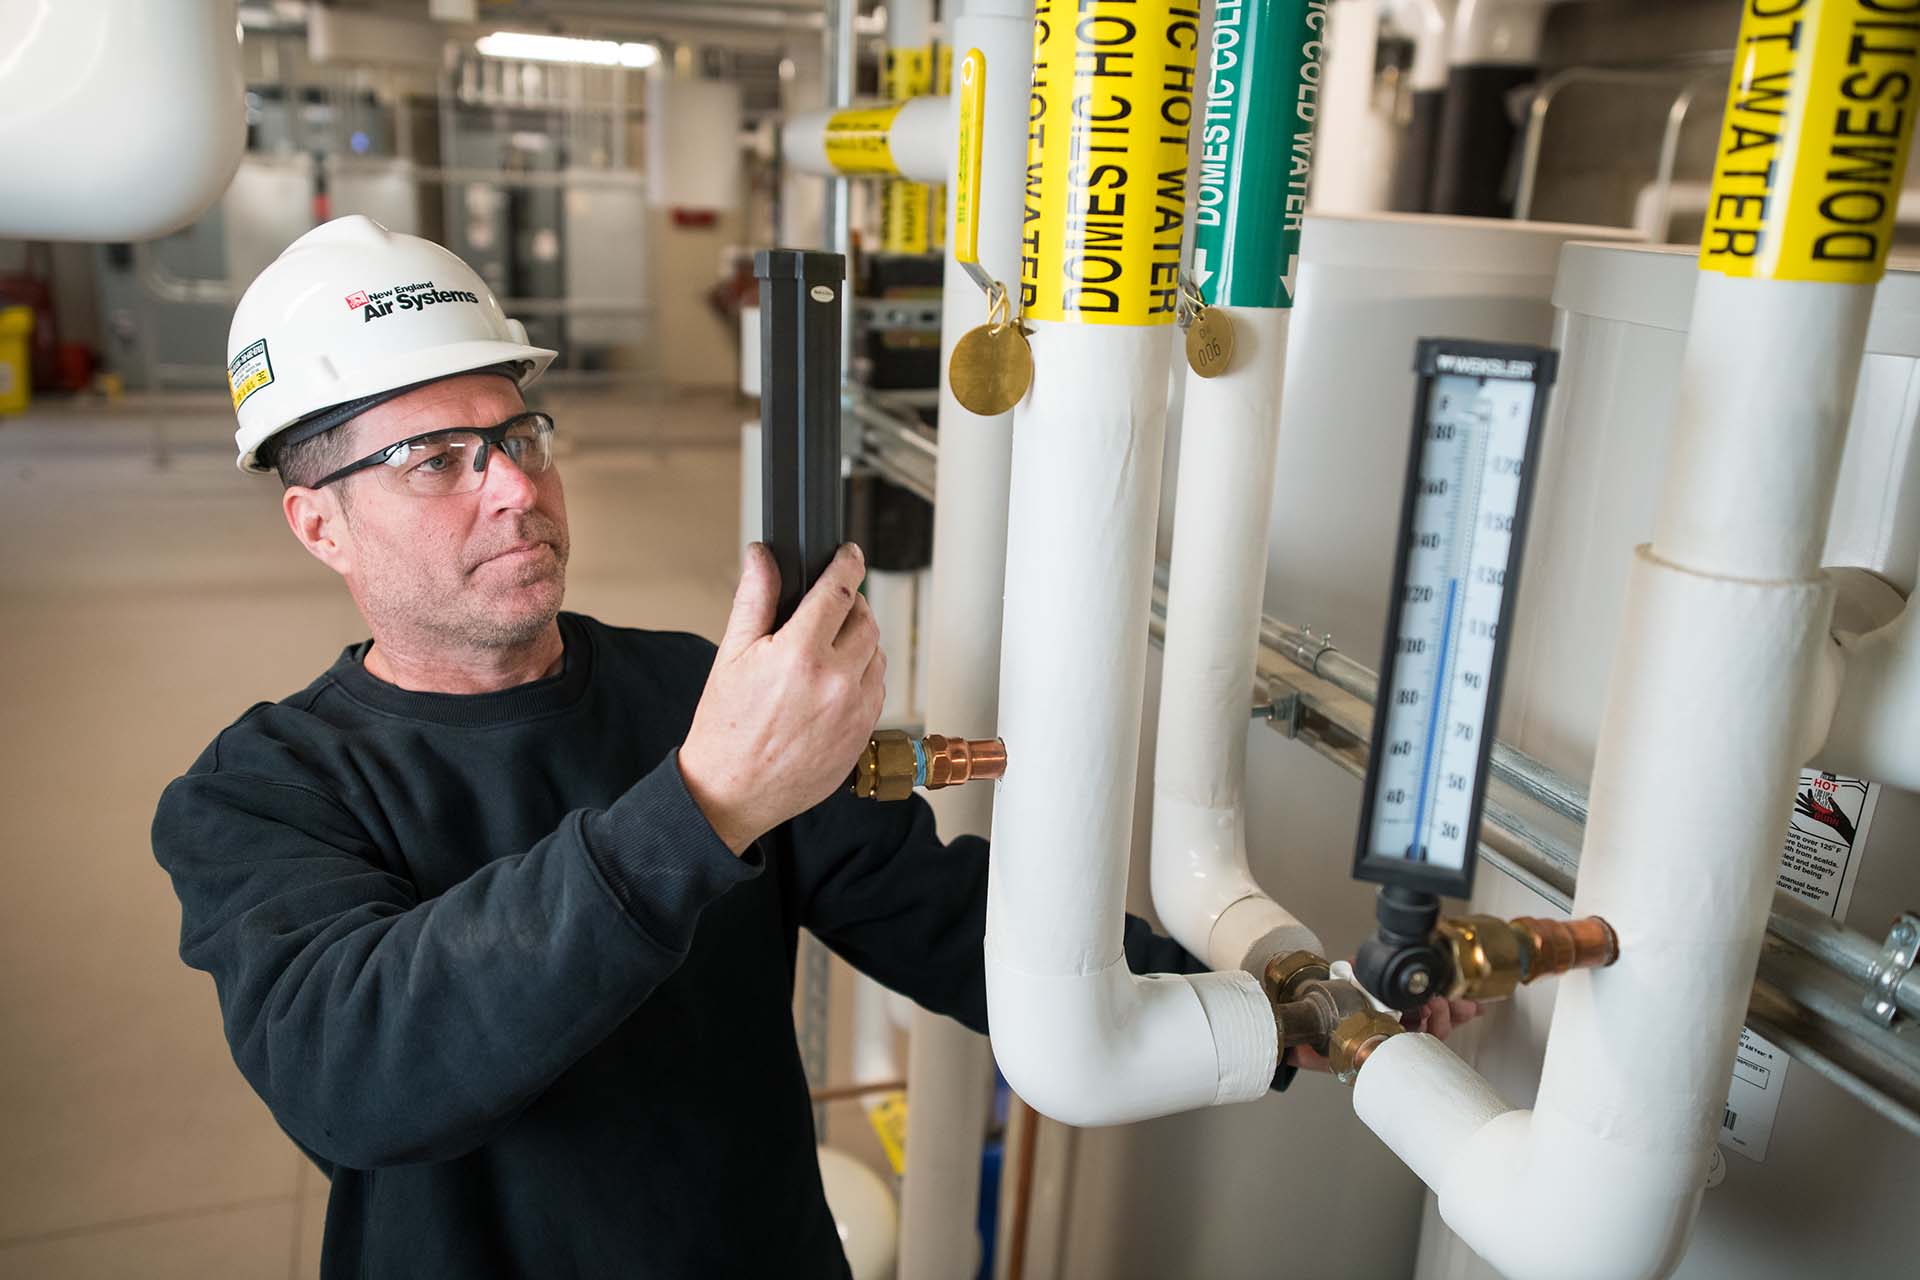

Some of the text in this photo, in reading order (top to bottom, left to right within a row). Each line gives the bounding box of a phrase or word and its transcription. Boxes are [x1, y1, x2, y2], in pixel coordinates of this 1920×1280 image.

[1160, 64, 1197, 154] HOT
[1296, 41, 1322, 122] COLD
[1195, 79, 1235, 226] DOMESTIC
[1283, 130, 1313, 231] WATER
[1709, 71, 1793, 257] WATER
[1062, 95, 1132, 313] DOMESTIC
[1149, 169, 1190, 315] WATER
[364, 289, 479, 322] Air Systems
[369, 281, 434, 302] New England
[1814, 779, 1838, 792] HOT
[1796, 849, 1812, 859] from
[1802, 837, 1818, 846] over
